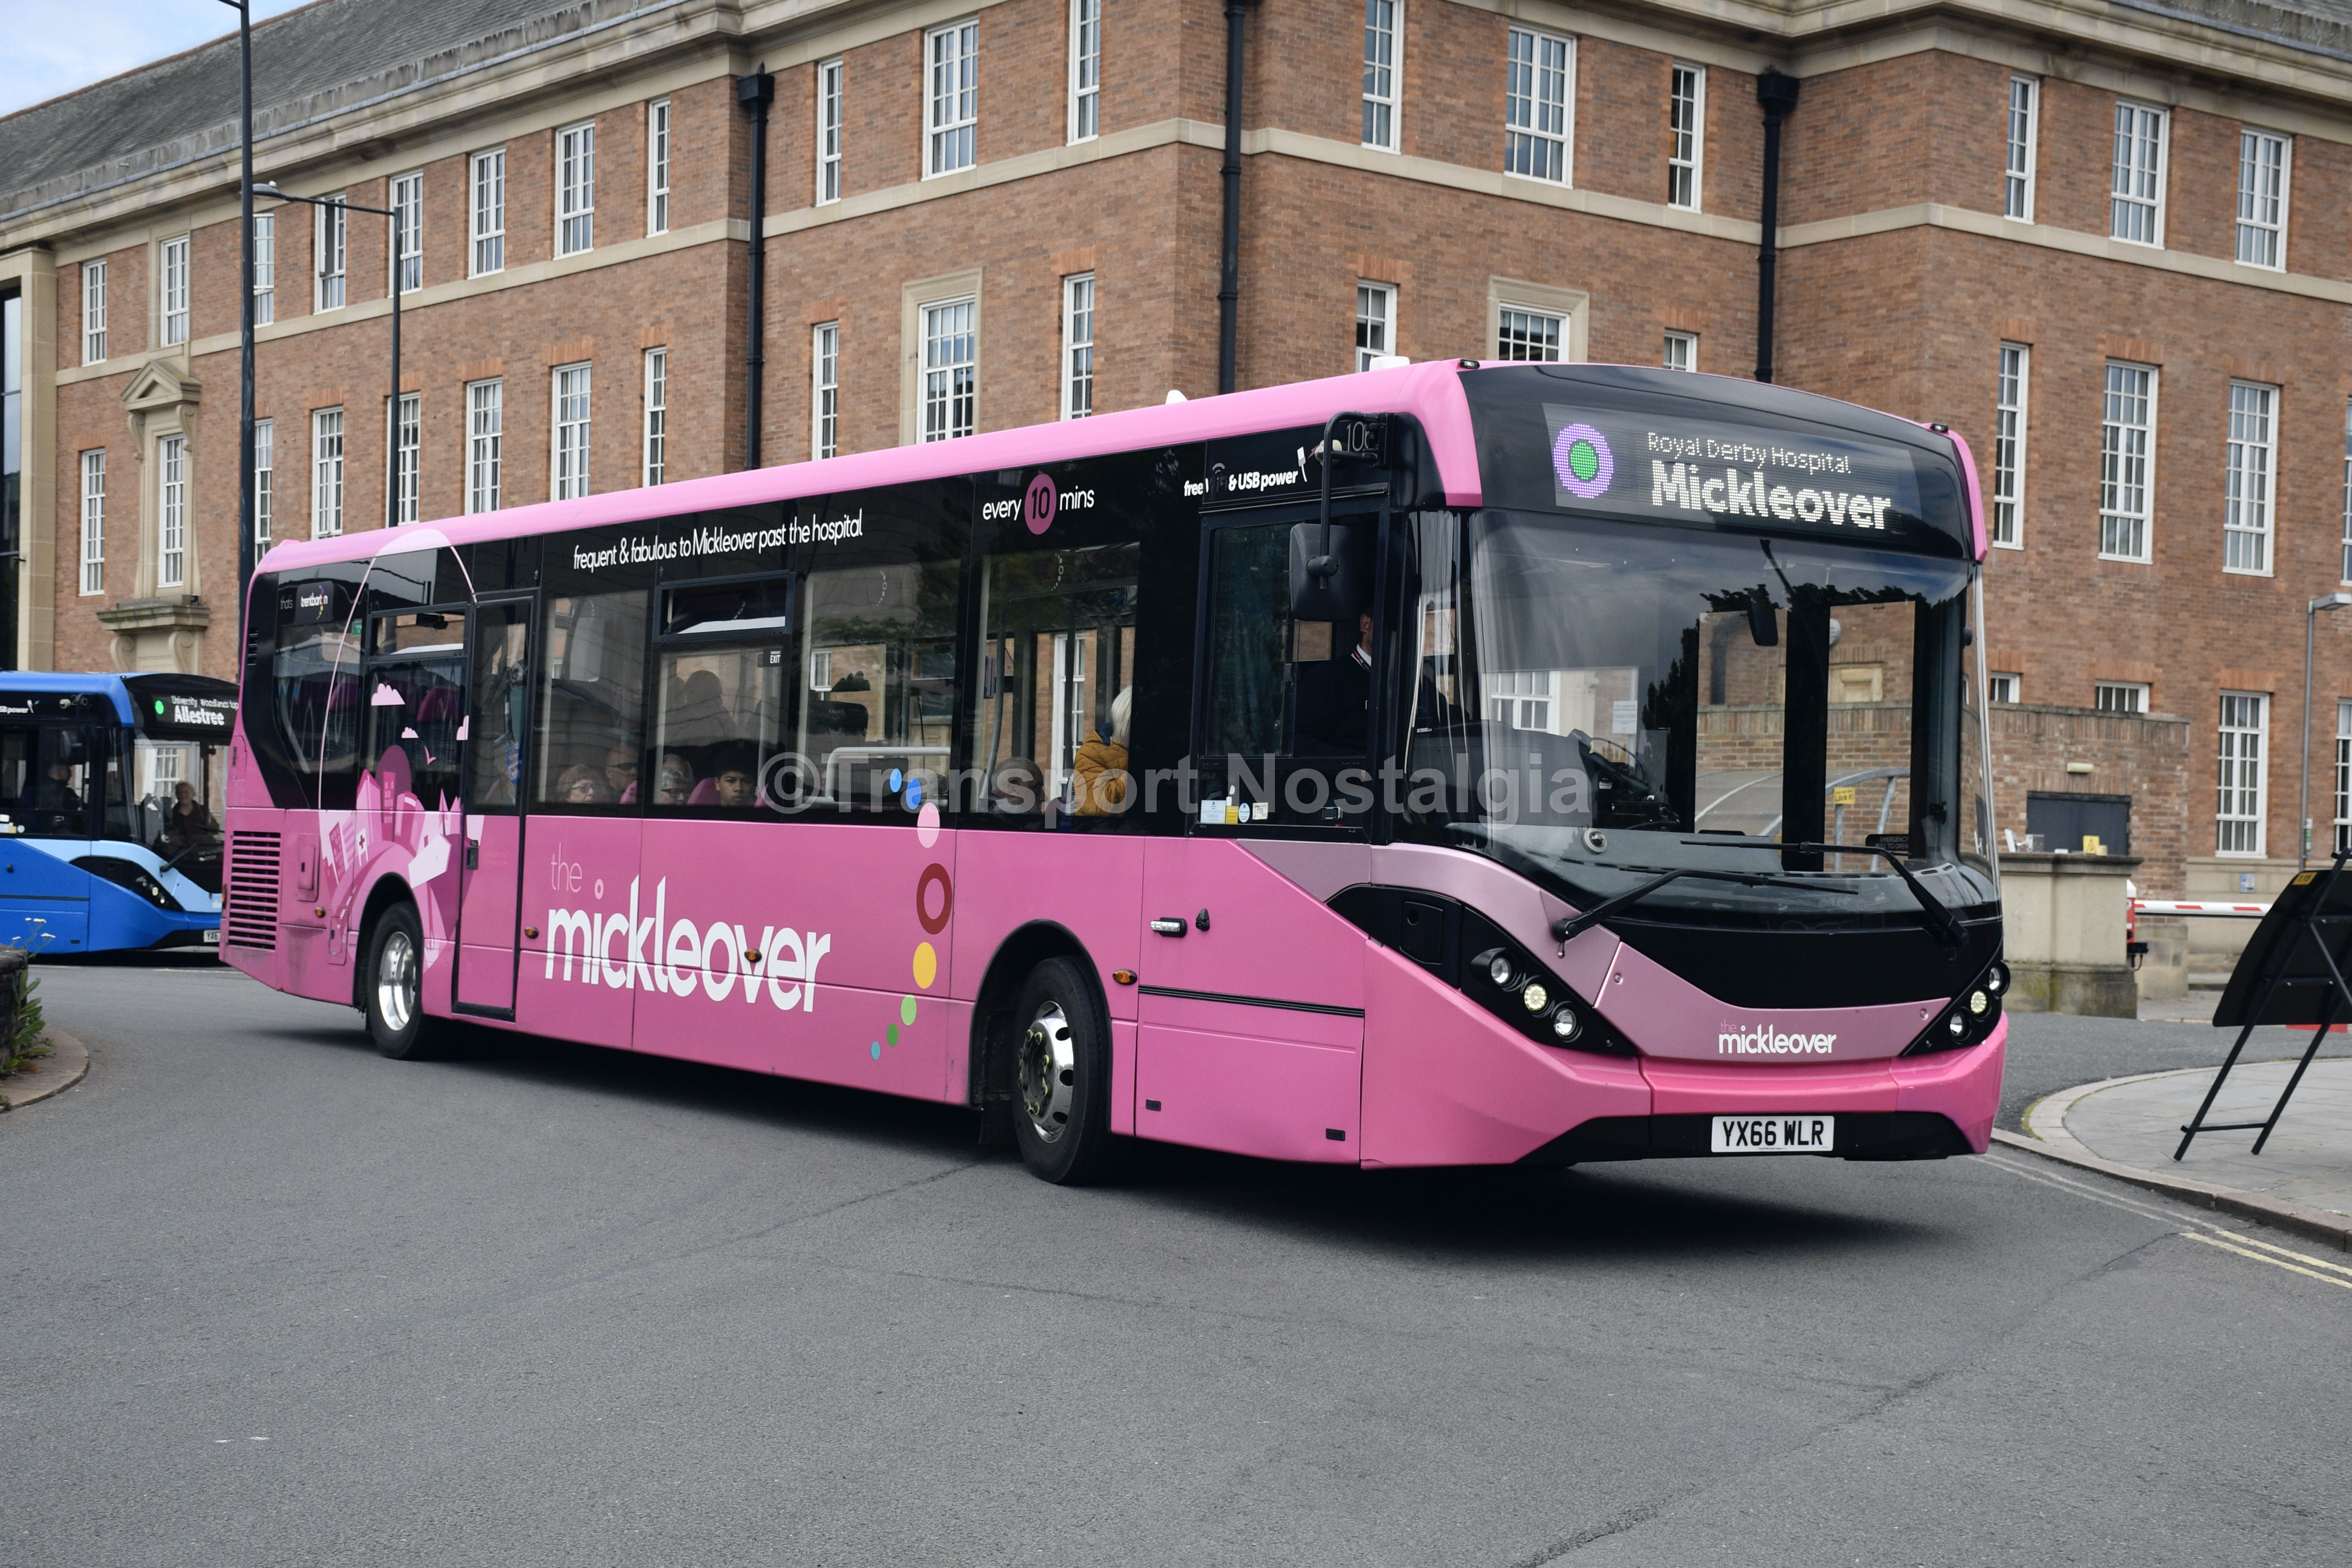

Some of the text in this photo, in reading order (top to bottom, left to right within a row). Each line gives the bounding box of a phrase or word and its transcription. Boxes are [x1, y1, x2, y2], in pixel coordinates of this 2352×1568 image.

[1648, 432, 1851, 475] Royal Derby Hospital
[1184, 480, 1203, 496] free
[1228, 474, 1237, 491] &
[1238, 471, 1260, 490] USB
[1260, 471, 1298, 492] power
[1652, 460, 1891, 530] Mickleover
[983, 485, 1095, 521] every 10 mins
[574, 507, 863, 574] frequent & fabulous to Mickleover past the hospital
[300, 592, 328, 607] trentbarton
[770, 654, 781, 664] EXIT
[174, 705, 225, 726] Allestree
[551, 842, 583, 893] the
[545, 874, 831, 1013] mickleover
[1719, 1024, 1837, 1054] mickleover
[1721, 1019, 1737, 1033] the
[1723, 1120, 1824, 1146] YX66 WLR
